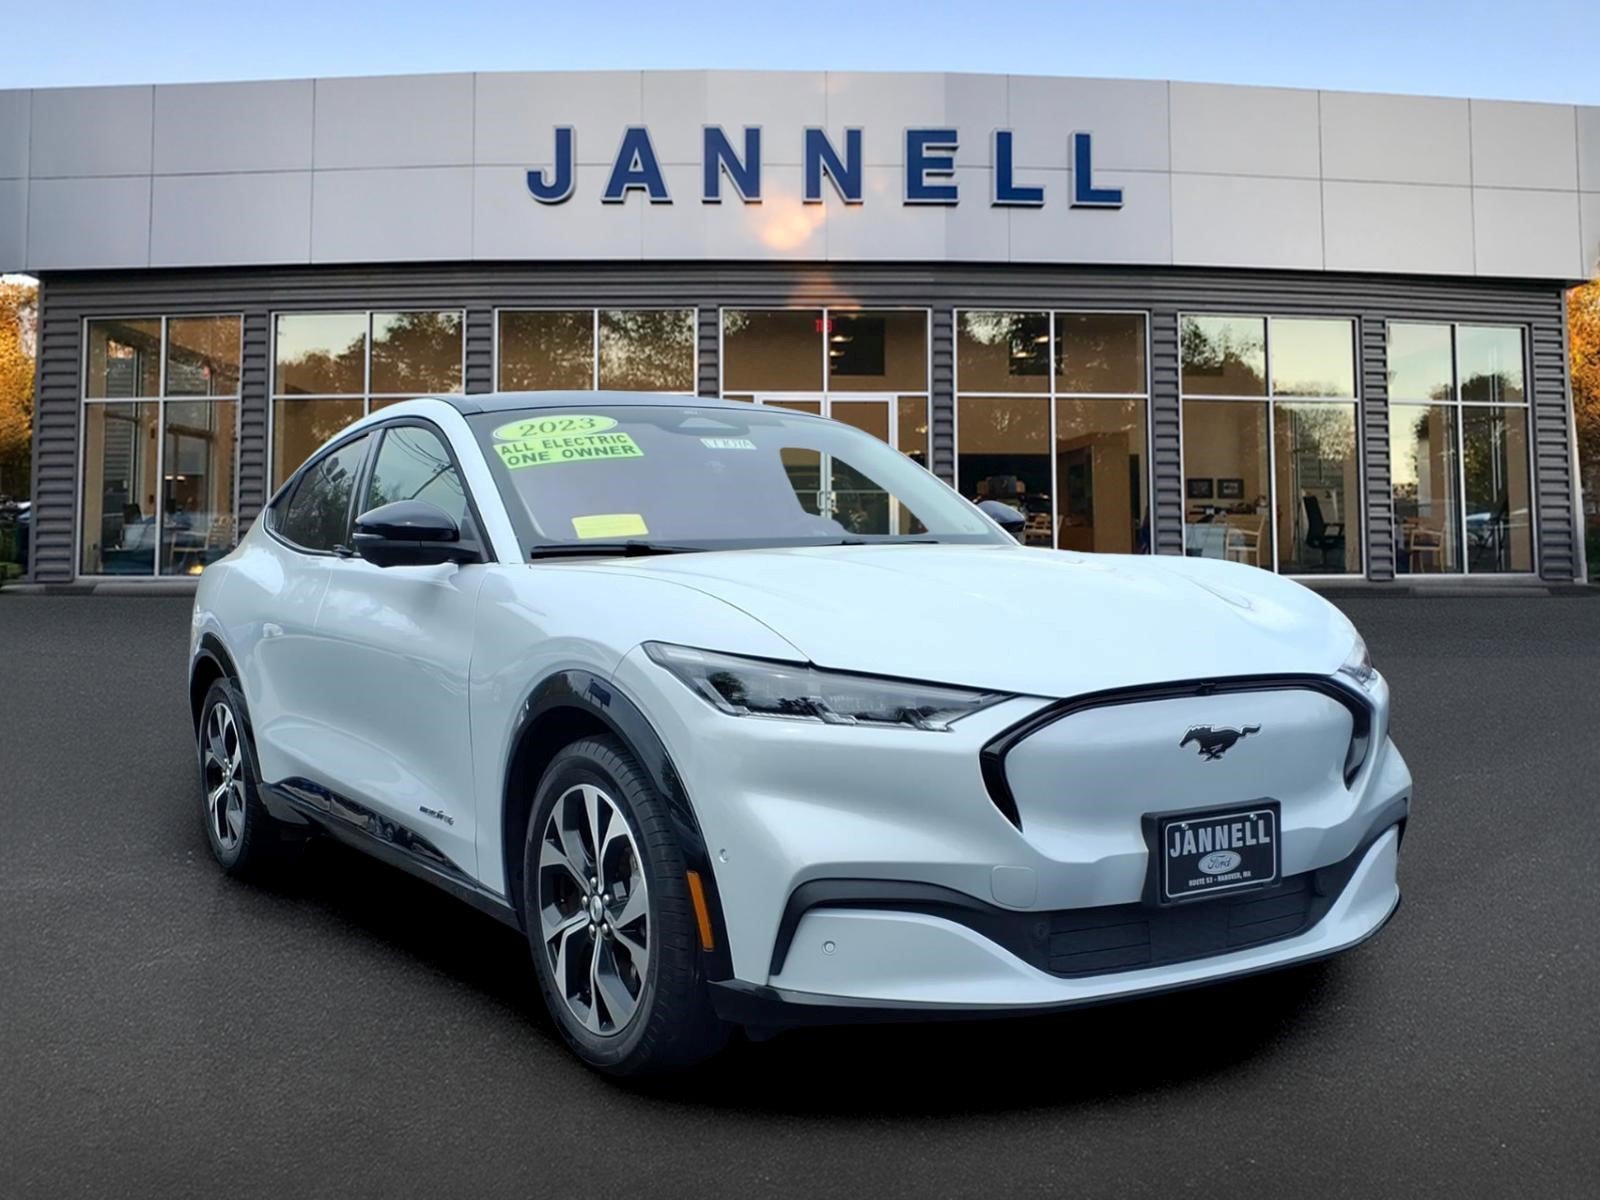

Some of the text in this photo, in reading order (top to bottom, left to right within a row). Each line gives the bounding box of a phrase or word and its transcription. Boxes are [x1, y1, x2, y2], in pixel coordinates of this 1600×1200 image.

[525, 124, 1124, 208] JANNELL
[519, 417, 596, 438] 2023
[501, 434, 629, 455] ALL ELECTRIC
[507, 444, 637, 466] ONE OWNER
[1169, 819, 1271, 858] JANNELL
[1207, 854, 1232, 870] Ford
